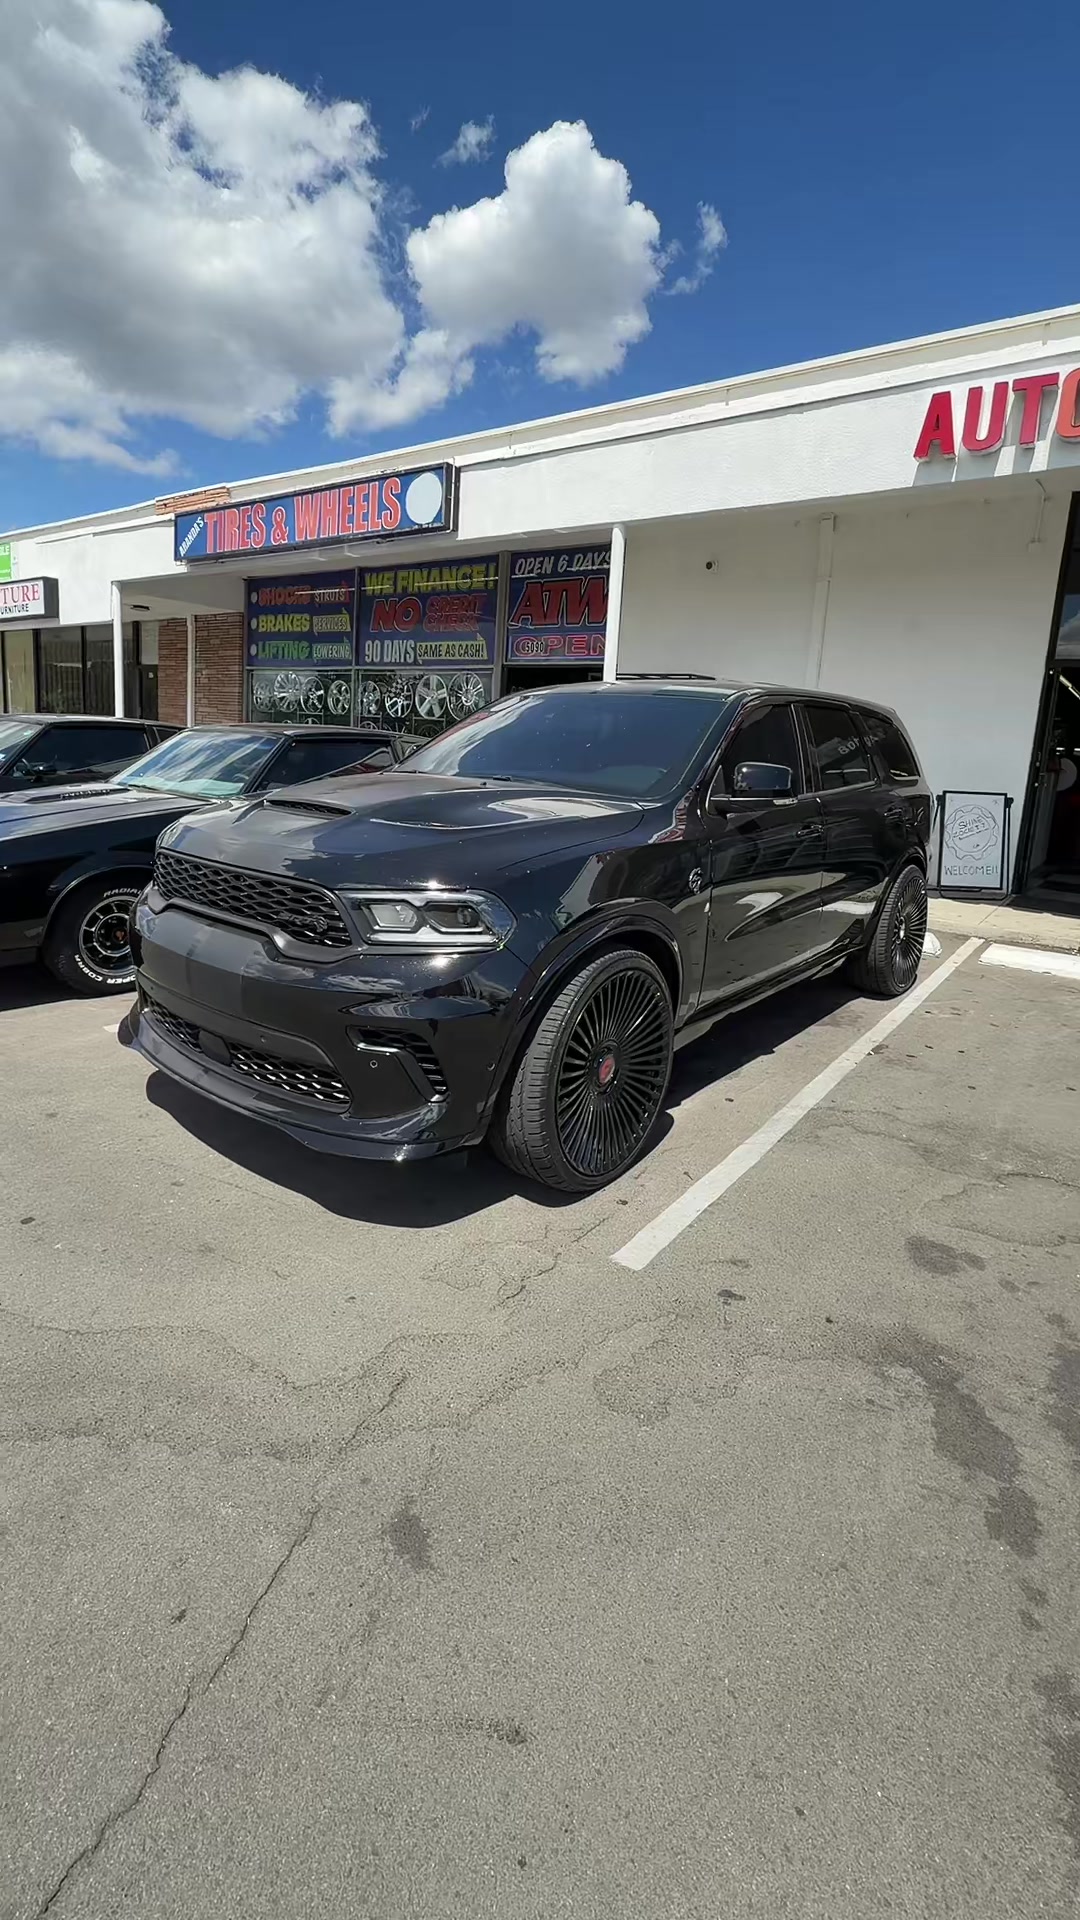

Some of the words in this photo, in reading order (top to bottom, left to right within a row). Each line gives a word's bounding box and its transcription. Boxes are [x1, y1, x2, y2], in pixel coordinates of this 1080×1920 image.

[204, 503, 266, 554] TIRES
[270, 507, 289, 545] &
[294, 477, 401, 541] WHEELS
[515, 555, 555, 575] OPEN
[558, 554, 568, 573] 6
[365, 572, 394, 596] WE
[397, 563, 496, 594] FINANCE!
[258, 585, 311, 606] SHOCKS
[314, 589, 345, 602] STRUTS
[426, 593, 487, 614] CREDIT
[258, 613, 310, 632] BRAKES
[314, 616, 346, 630] SERVICES
[370, 597, 422, 632] NO
[423, 612, 479, 632] CHECK
[258, 641, 310, 660] LIFTING
[313, 645, 350, 659] LOWERING
[365, 640, 380, 663] 90
[383, 640, 415, 663] DAYS
[418, 643, 443, 658] SAME
[445, 643, 456, 657] AS
[458, 643, 484, 658] CASH!
[514, 634, 606, 657] OPEN
[74, 954, 103, 982] COBRA
